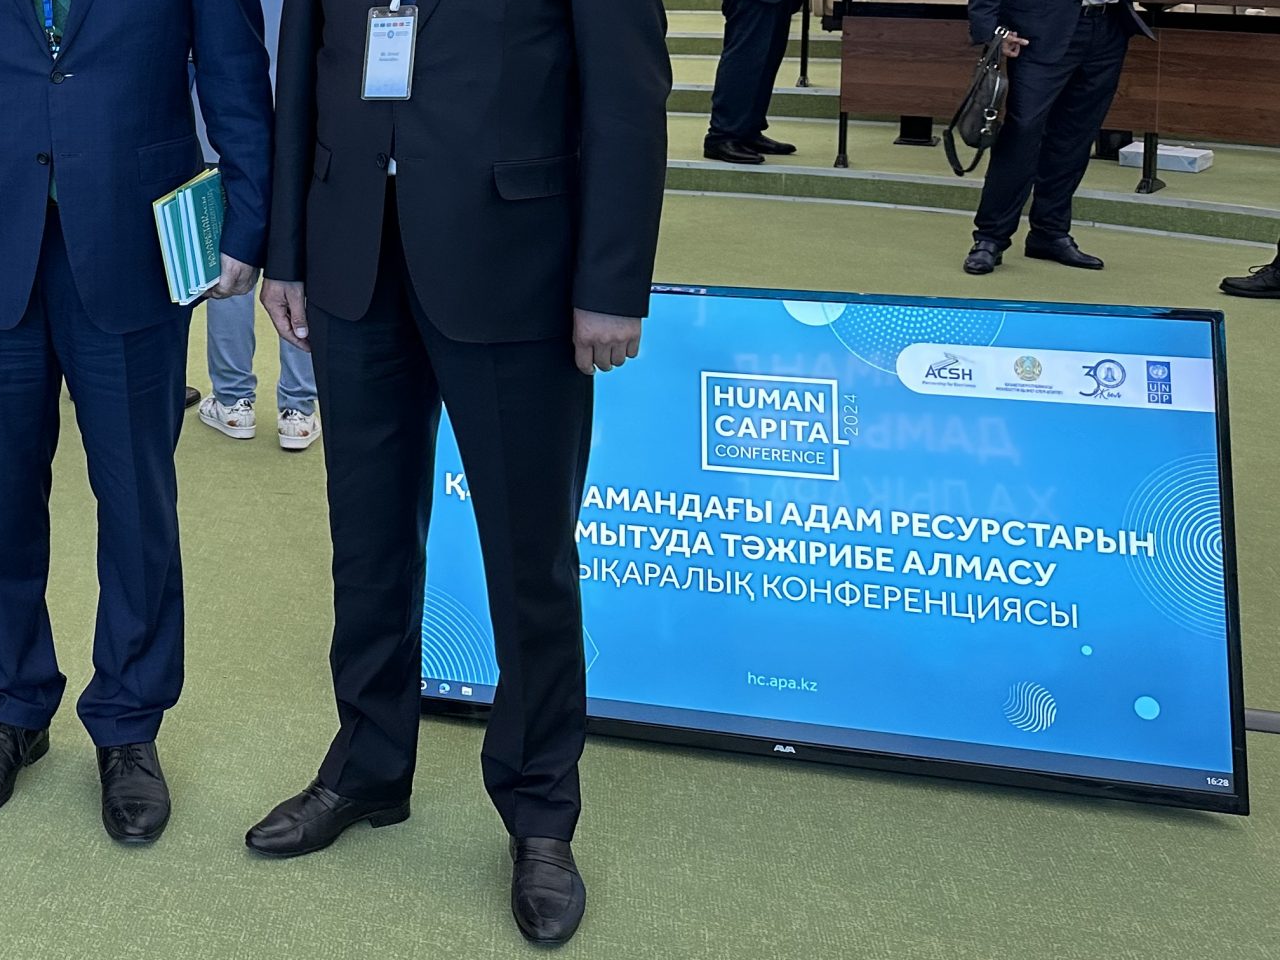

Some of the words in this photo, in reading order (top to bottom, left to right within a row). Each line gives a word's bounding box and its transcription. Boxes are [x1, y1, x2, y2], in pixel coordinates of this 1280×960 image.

[925, 365, 973, 381] ACSH
[715, 386, 825, 413] HUMAN
[844, 394, 858, 436] 2024
[715, 444, 826, 465] CONFERENCE
[583, 485, 772, 524] АМАНДАҒЫ
[780, 504, 882, 534] АДАМ
[891, 510, 1155, 557] РЕСУРСТАРЫН
[575, 520, 714, 558] МЫТУДА
[721, 533, 895, 572] ТӘЖІРИБЕ
[902, 550, 1056, 587] АЛМАСУ
[578, 557, 756, 602] ЫҚАРАЛЫҚ
[762, 574, 1079, 628] КОНФЕРЕНЦИЯСЫ
[747, 671, 818, 692] hc.apa.kz
[1206, 777, 1229, 787] 16:28
